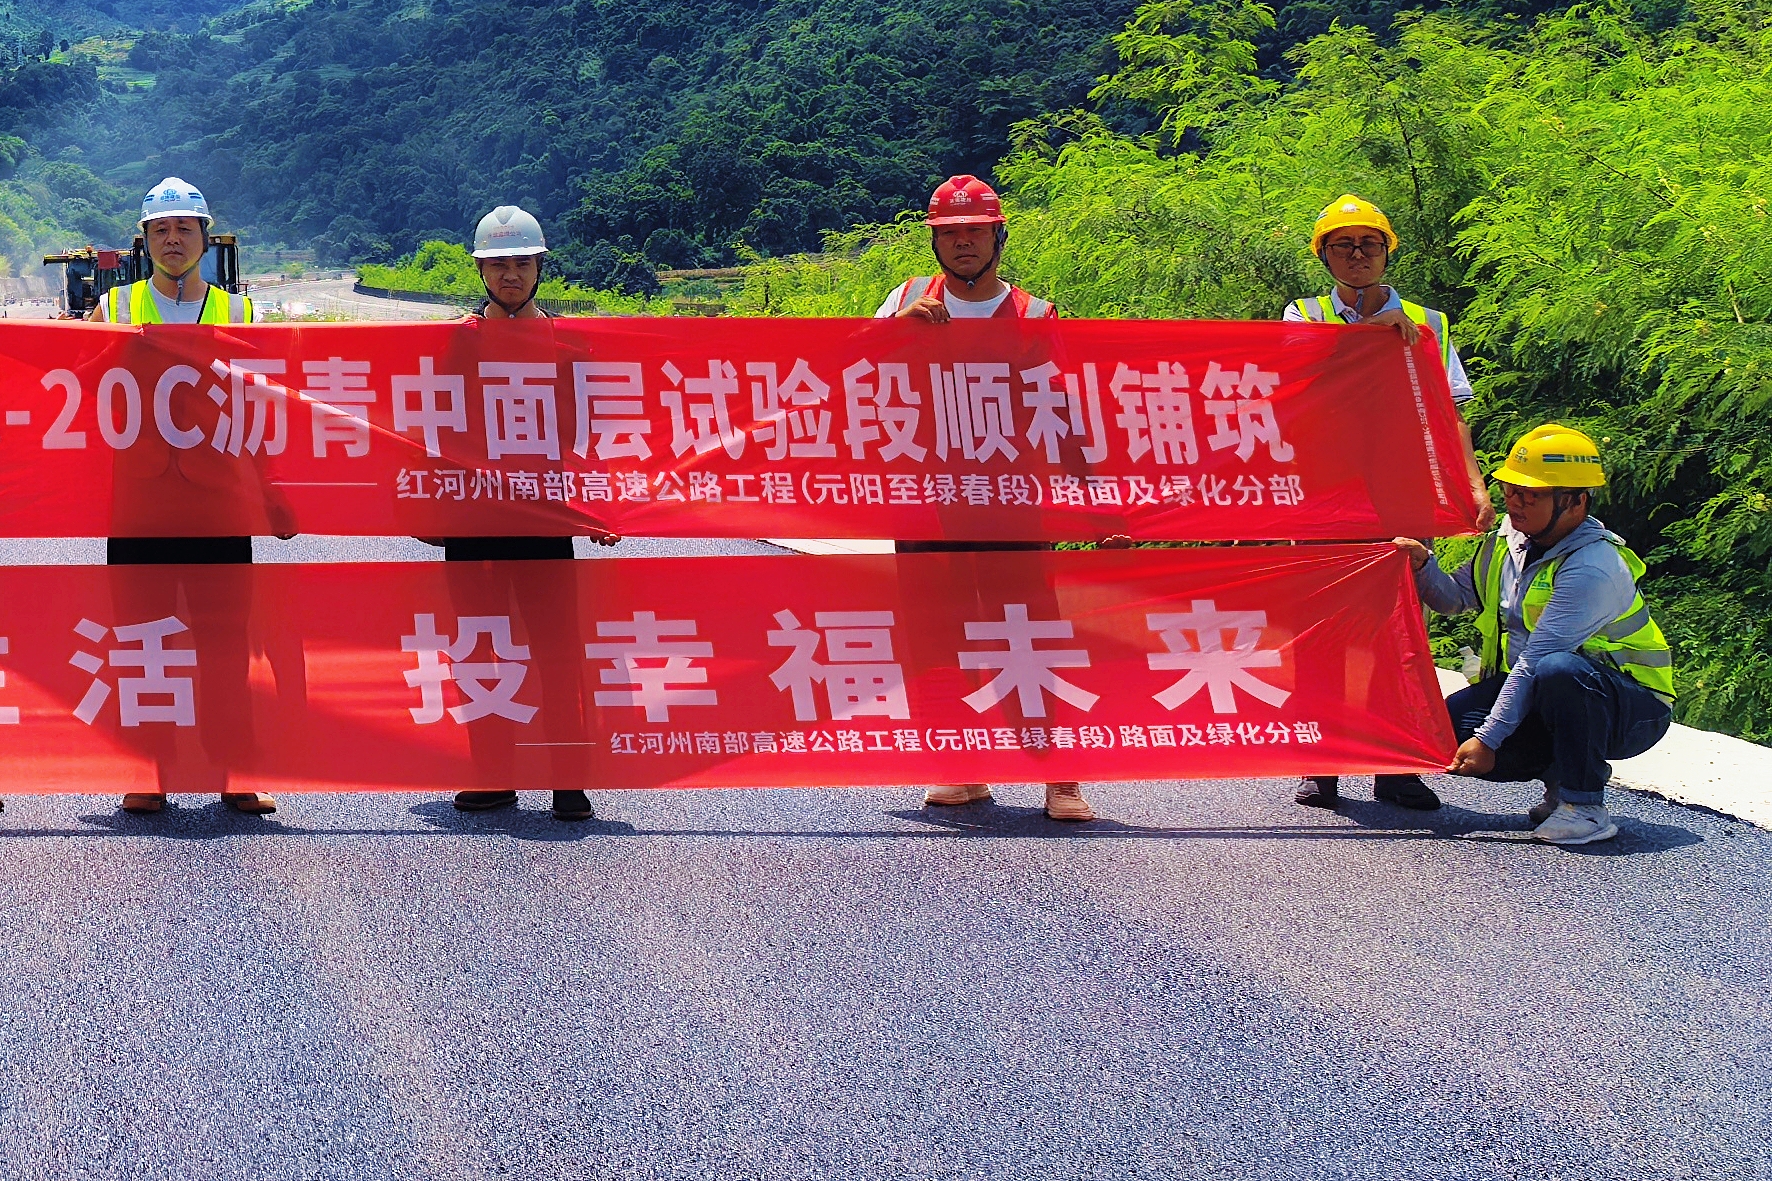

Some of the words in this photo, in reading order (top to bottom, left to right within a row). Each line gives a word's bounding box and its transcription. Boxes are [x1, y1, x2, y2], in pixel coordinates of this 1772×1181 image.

[396, 466, 1305, 507] 红河州南部高速公路工程(元阳至绿春段)路面及绿化分部
[400, 599, 1294, 724] 投幸福未来
[610, 720, 1323, 756] 红河州南部高速公路工程(元阳至绿春段)路面及绿化分部
